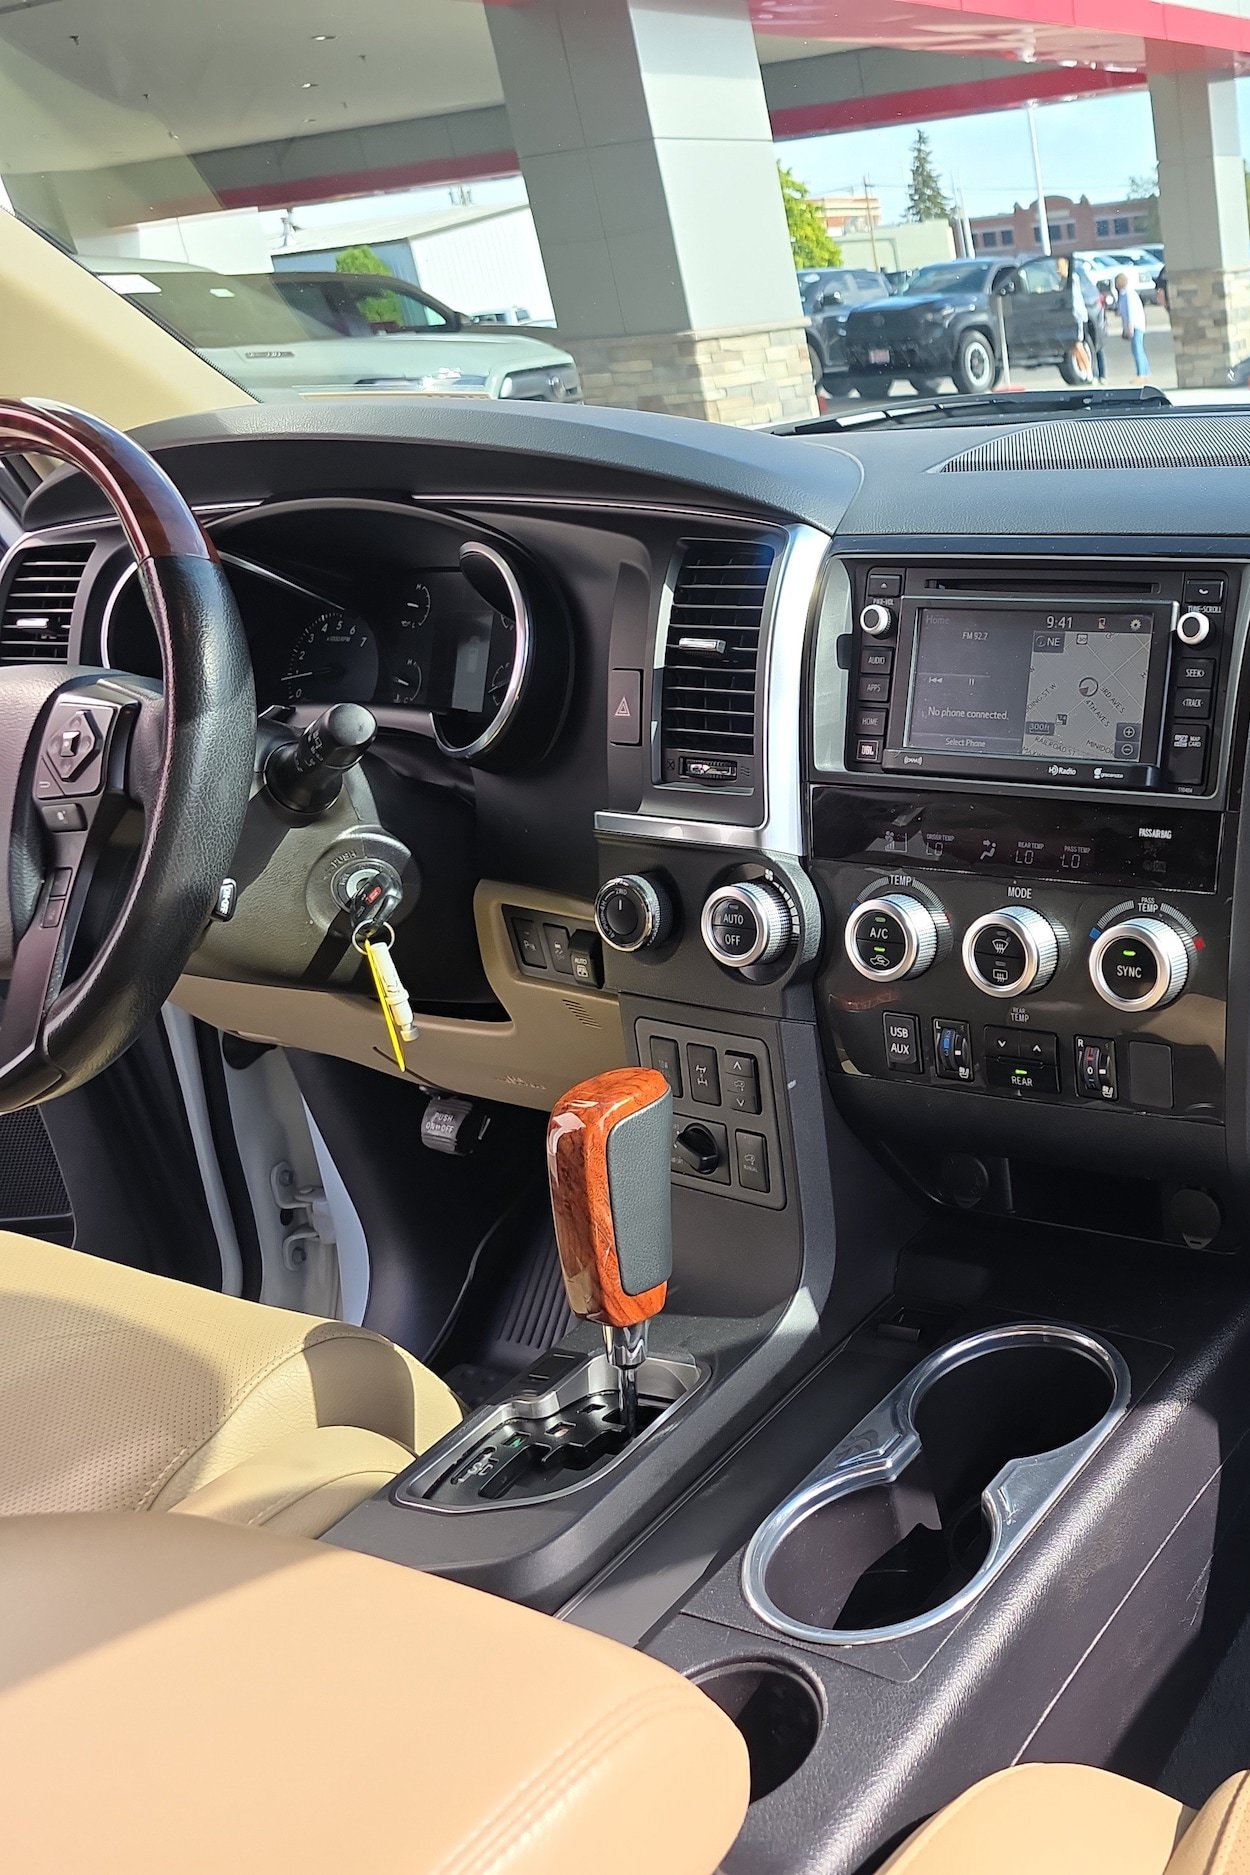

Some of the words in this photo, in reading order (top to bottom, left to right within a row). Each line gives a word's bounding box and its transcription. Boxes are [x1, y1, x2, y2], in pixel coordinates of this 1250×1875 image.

[925, 614, 950, 625] Home
[1046, 615, 1073, 629] 9:41
[962, 632, 973, 640] FM
[1047, 637, 1060, 647] NE
[868, 656, 886, 665] AUDIO
[866, 683, 881, 692] APPS
[928, 706, 940, 717] No
[941, 707, 965, 718] phone
[966, 710, 1009, 721] connected.
[862, 717, 879, 726] HOME
[945, 738, 964, 747] Select
[965, 739, 986, 748] Phone
[1059, 766, 1077, 775] Radio
[889, 874, 912, 887] TEMP
[1007, 886, 1033, 899] MODE
[1137, 902, 1159, 913] TEMP
[723, 913, 744, 925] AUTO
[869, 926, 889, 940] A/C
[724, 934, 741, 946] OFF
[1116, 965, 1142, 978] SYNC
[1010, 1012, 1030, 1022] TEMP
[935, 1020, 942, 1030] L
[890, 1026, 909, 1038] USB
[890, 1042, 910, 1055] AUX
[1077, 1039, 1084, 1047] R
[1011, 1075, 1033, 1087] REAR
